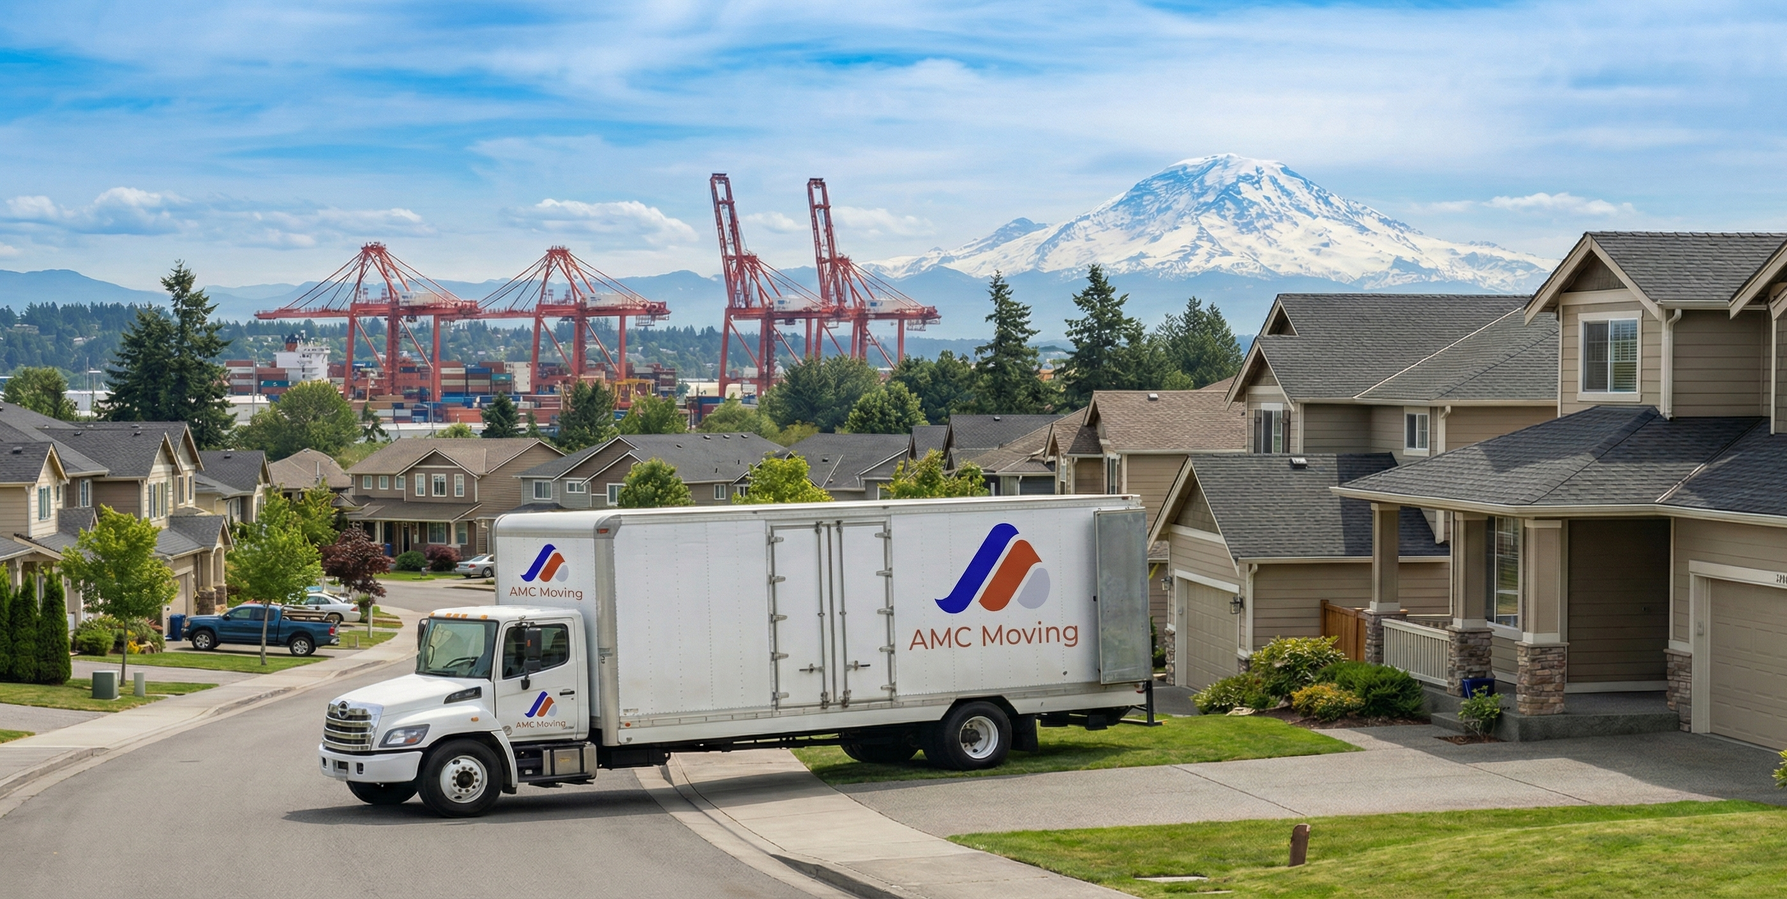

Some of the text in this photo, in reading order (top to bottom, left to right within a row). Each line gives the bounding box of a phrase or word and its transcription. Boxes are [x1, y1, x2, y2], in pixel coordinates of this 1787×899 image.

[509, 586, 583, 601] AMC Moving
[908, 620, 1079, 651] AMC Moving
[516, 721, 535, 729] AMC
[537, 719, 567, 729] Moving
